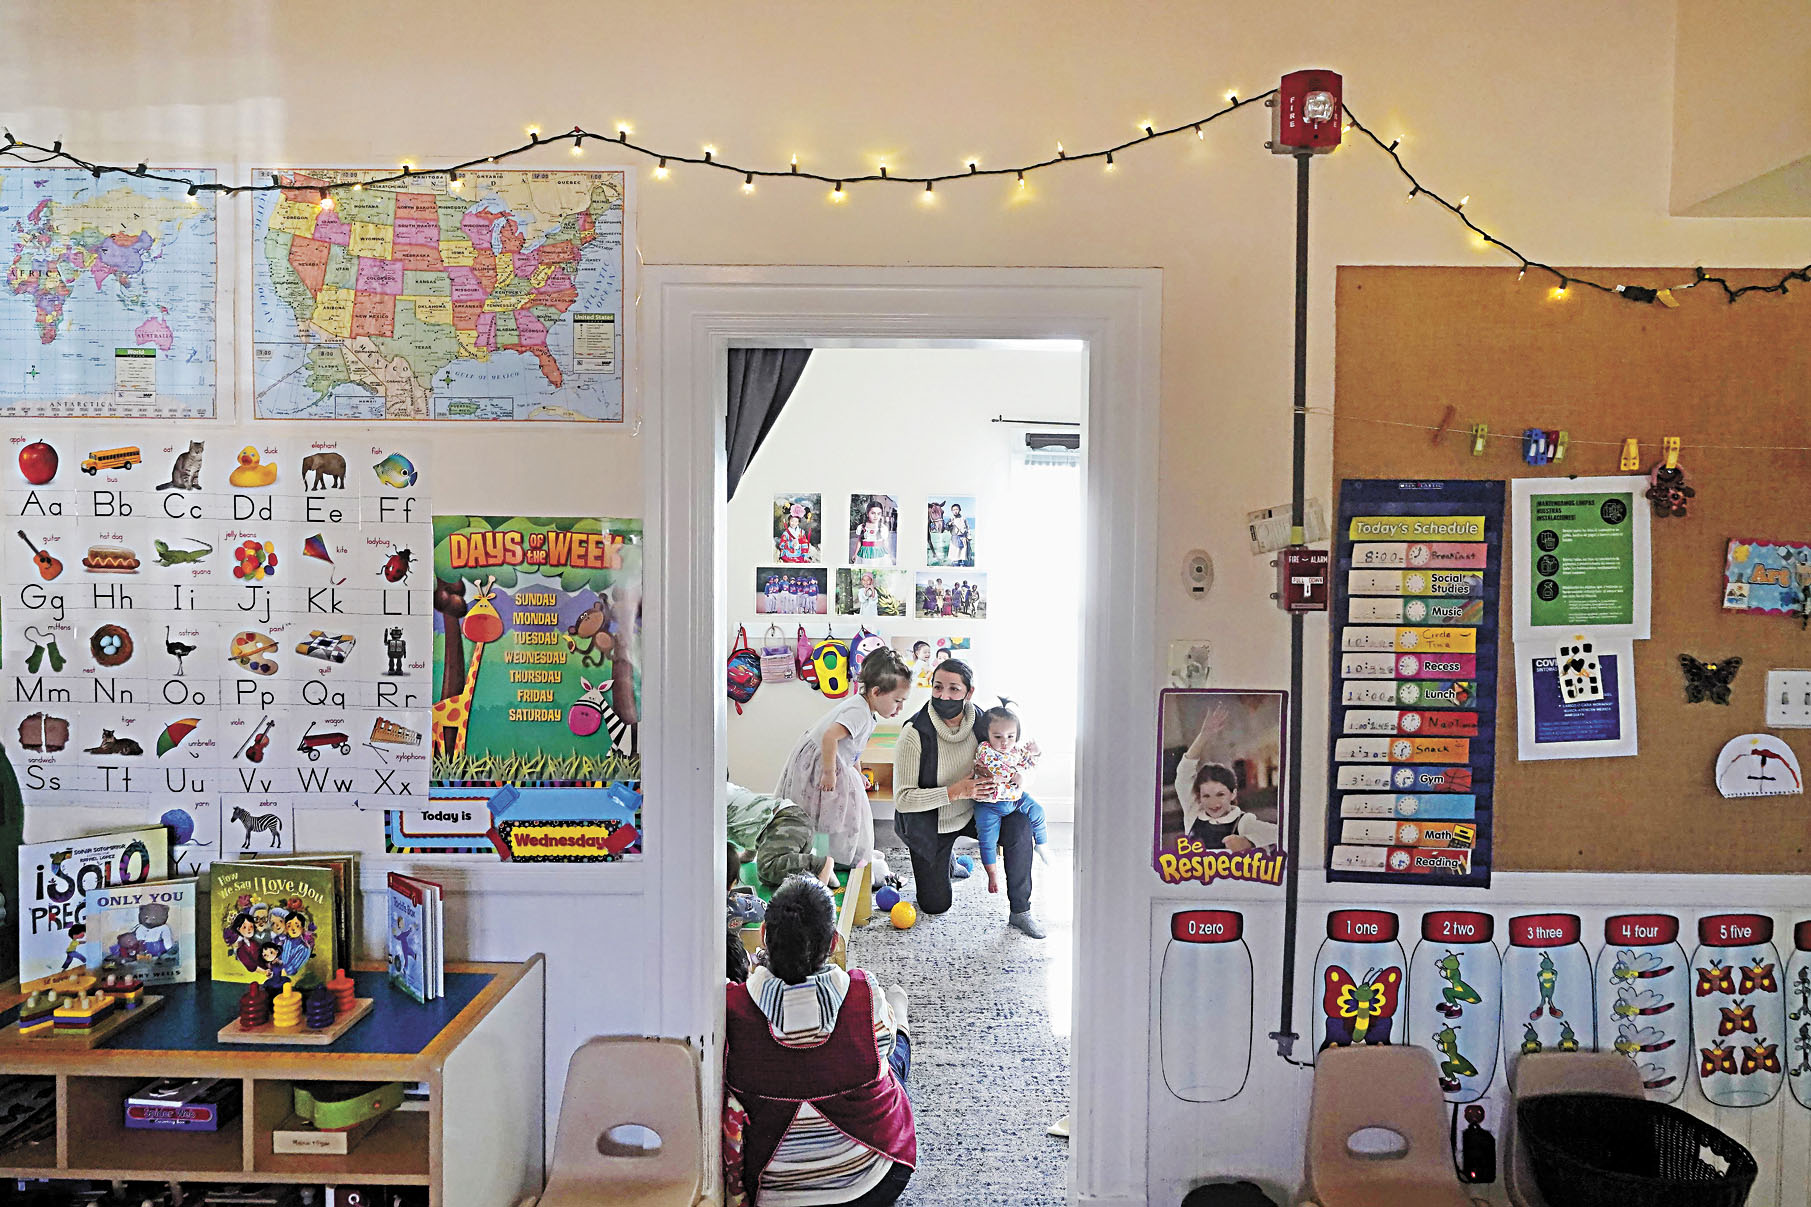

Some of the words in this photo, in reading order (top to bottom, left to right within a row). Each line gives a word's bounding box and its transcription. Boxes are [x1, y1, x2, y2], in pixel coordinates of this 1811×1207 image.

[10, 269, 61, 277] AFRICA
[20, 490, 62, 516] Aa
[94, 492, 132, 518] Bb
[163, 493, 202, 520] Cc
[234, 495, 272, 522] Dd
[306, 496, 343, 524] Ee
[379, 497, 416, 524] Ff
[1356, 522, 1408, 536] Today's
[1414, 522, 1478, 534] Schedule
[450, 530, 523, 568] DAYS
[529, 533, 545, 549] OF
[548, 530, 624, 570] WEEK
[1364, 551, 1398, 563] 8:00
[1431, 574, 1463, 583] Social
[1750, 562, 1792, 588] Art
[94, 584, 133, 610] Hh
[1431, 584, 1470, 594] Studies
[20, 584, 65, 622] Gg
[172, 584, 196, 611] Ii
[237, 586, 271, 624] Jj
[308, 588, 344, 614] Kk
[383, 589, 412, 616] Ll
[514, 594, 556, 606] SUNDAY
[512, 612, 558, 626] MONDAY
[1432, 608, 1462, 616] Music
[512, 632, 558, 645] TUESDAY
[1422, 629, 1451, 640] Circle
[504, 651, 566, 665] WEDNESDAY
[1424, 662, 1460, 670] Recess
[509, 670, 562, 684] THURSDAY
[16, 676, 70, 703] Mm
[94, 678, 132, 703] Nn
[162, 680, 206, 706] Oo
[236, 680, 274, 710] Pp
[302, 680, 345, 710] Qq
[378, 682, 418, 708] Rr
[517, 690, 554, 702] FRIDAY
[1425, 690, 1456, 699] Lunch
[508, 708, 562, 722] SATURDAY
[1416, 746, 1450, 755] Snack
[26, 764, 60, 790] Ss
[97, 766, 132, 793] Tt
[166, 767, 204, 794] Uu
[238, 768, 272, 794] Vv
[297, 768, 354, 794] Ww
[374, 768, 412, 796] Xx
[1420, 774, 1444, 784] Gym
[421, 810, 458, 823] Today
[461, 810, 472, 821] is
[514, 833, 606, 850] Wednesday
[1424, 830, 1452, 840] Math
[1177, 837, 1204, 855] Be
[1158, 851, 1284, 884] Respectful
[1416, 856, 1459, 868] Reading
[218, 872, 238, 886] How
[234, 880, 252, 891] Say
[254, 877, 258, 891] I
[262, 878, 294, 894] Love
[97, 894, 142, 907] ONLY
[149, 892, 184, 903] YOU
[1188, 920, 1196, 934] 0
[1198, 922, 1224, 935] zero
[1346, 920, 1352, 934] 1
[1355, 922, 1378, 934] one
[1442, 921, 1450, 934] 2
[1454, 922, 1475, 936] two
[1527, 927, 1534, 939] 3
[1536, 926, 1563, 938] three
[1622, 925, 1631, 938] 4
[1634, 924, 1659, 938] four
[1720, 925, 1727, 938] 5
[1729, 924, 1752, 938] five
[152, 970, 181, 978] WELLS
